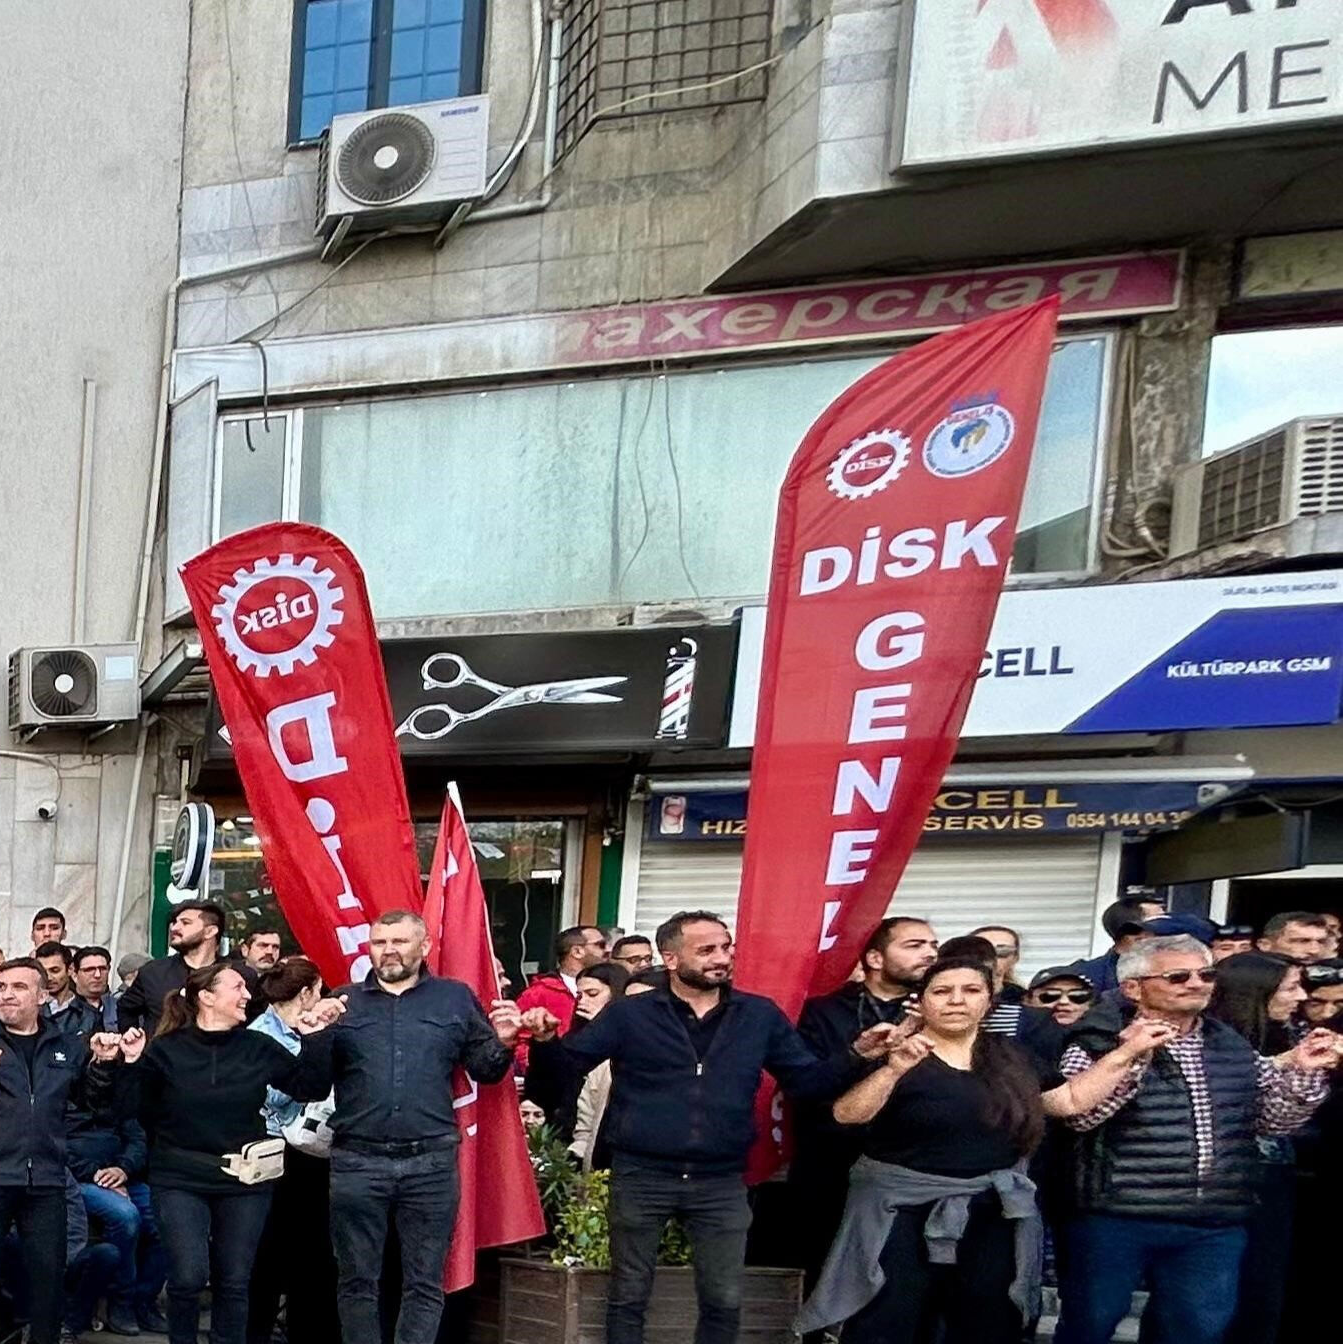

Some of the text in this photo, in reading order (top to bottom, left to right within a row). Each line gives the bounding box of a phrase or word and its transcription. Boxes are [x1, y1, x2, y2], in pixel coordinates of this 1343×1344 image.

[556, 265, 1123, 353] ахерская
[799, 515, 1008, 596] DİSK
[1165, 656, 1333, 679] KÜLTÜRPARK GSM
[929, 787, 1079, 811] CELL
[922, 810, 1045, 832] SERVİS
[1066, 812, 1106, 829] 0554
[1110, 811, 1141, 827] 144
[1144, 811, 1167, 825] 04
